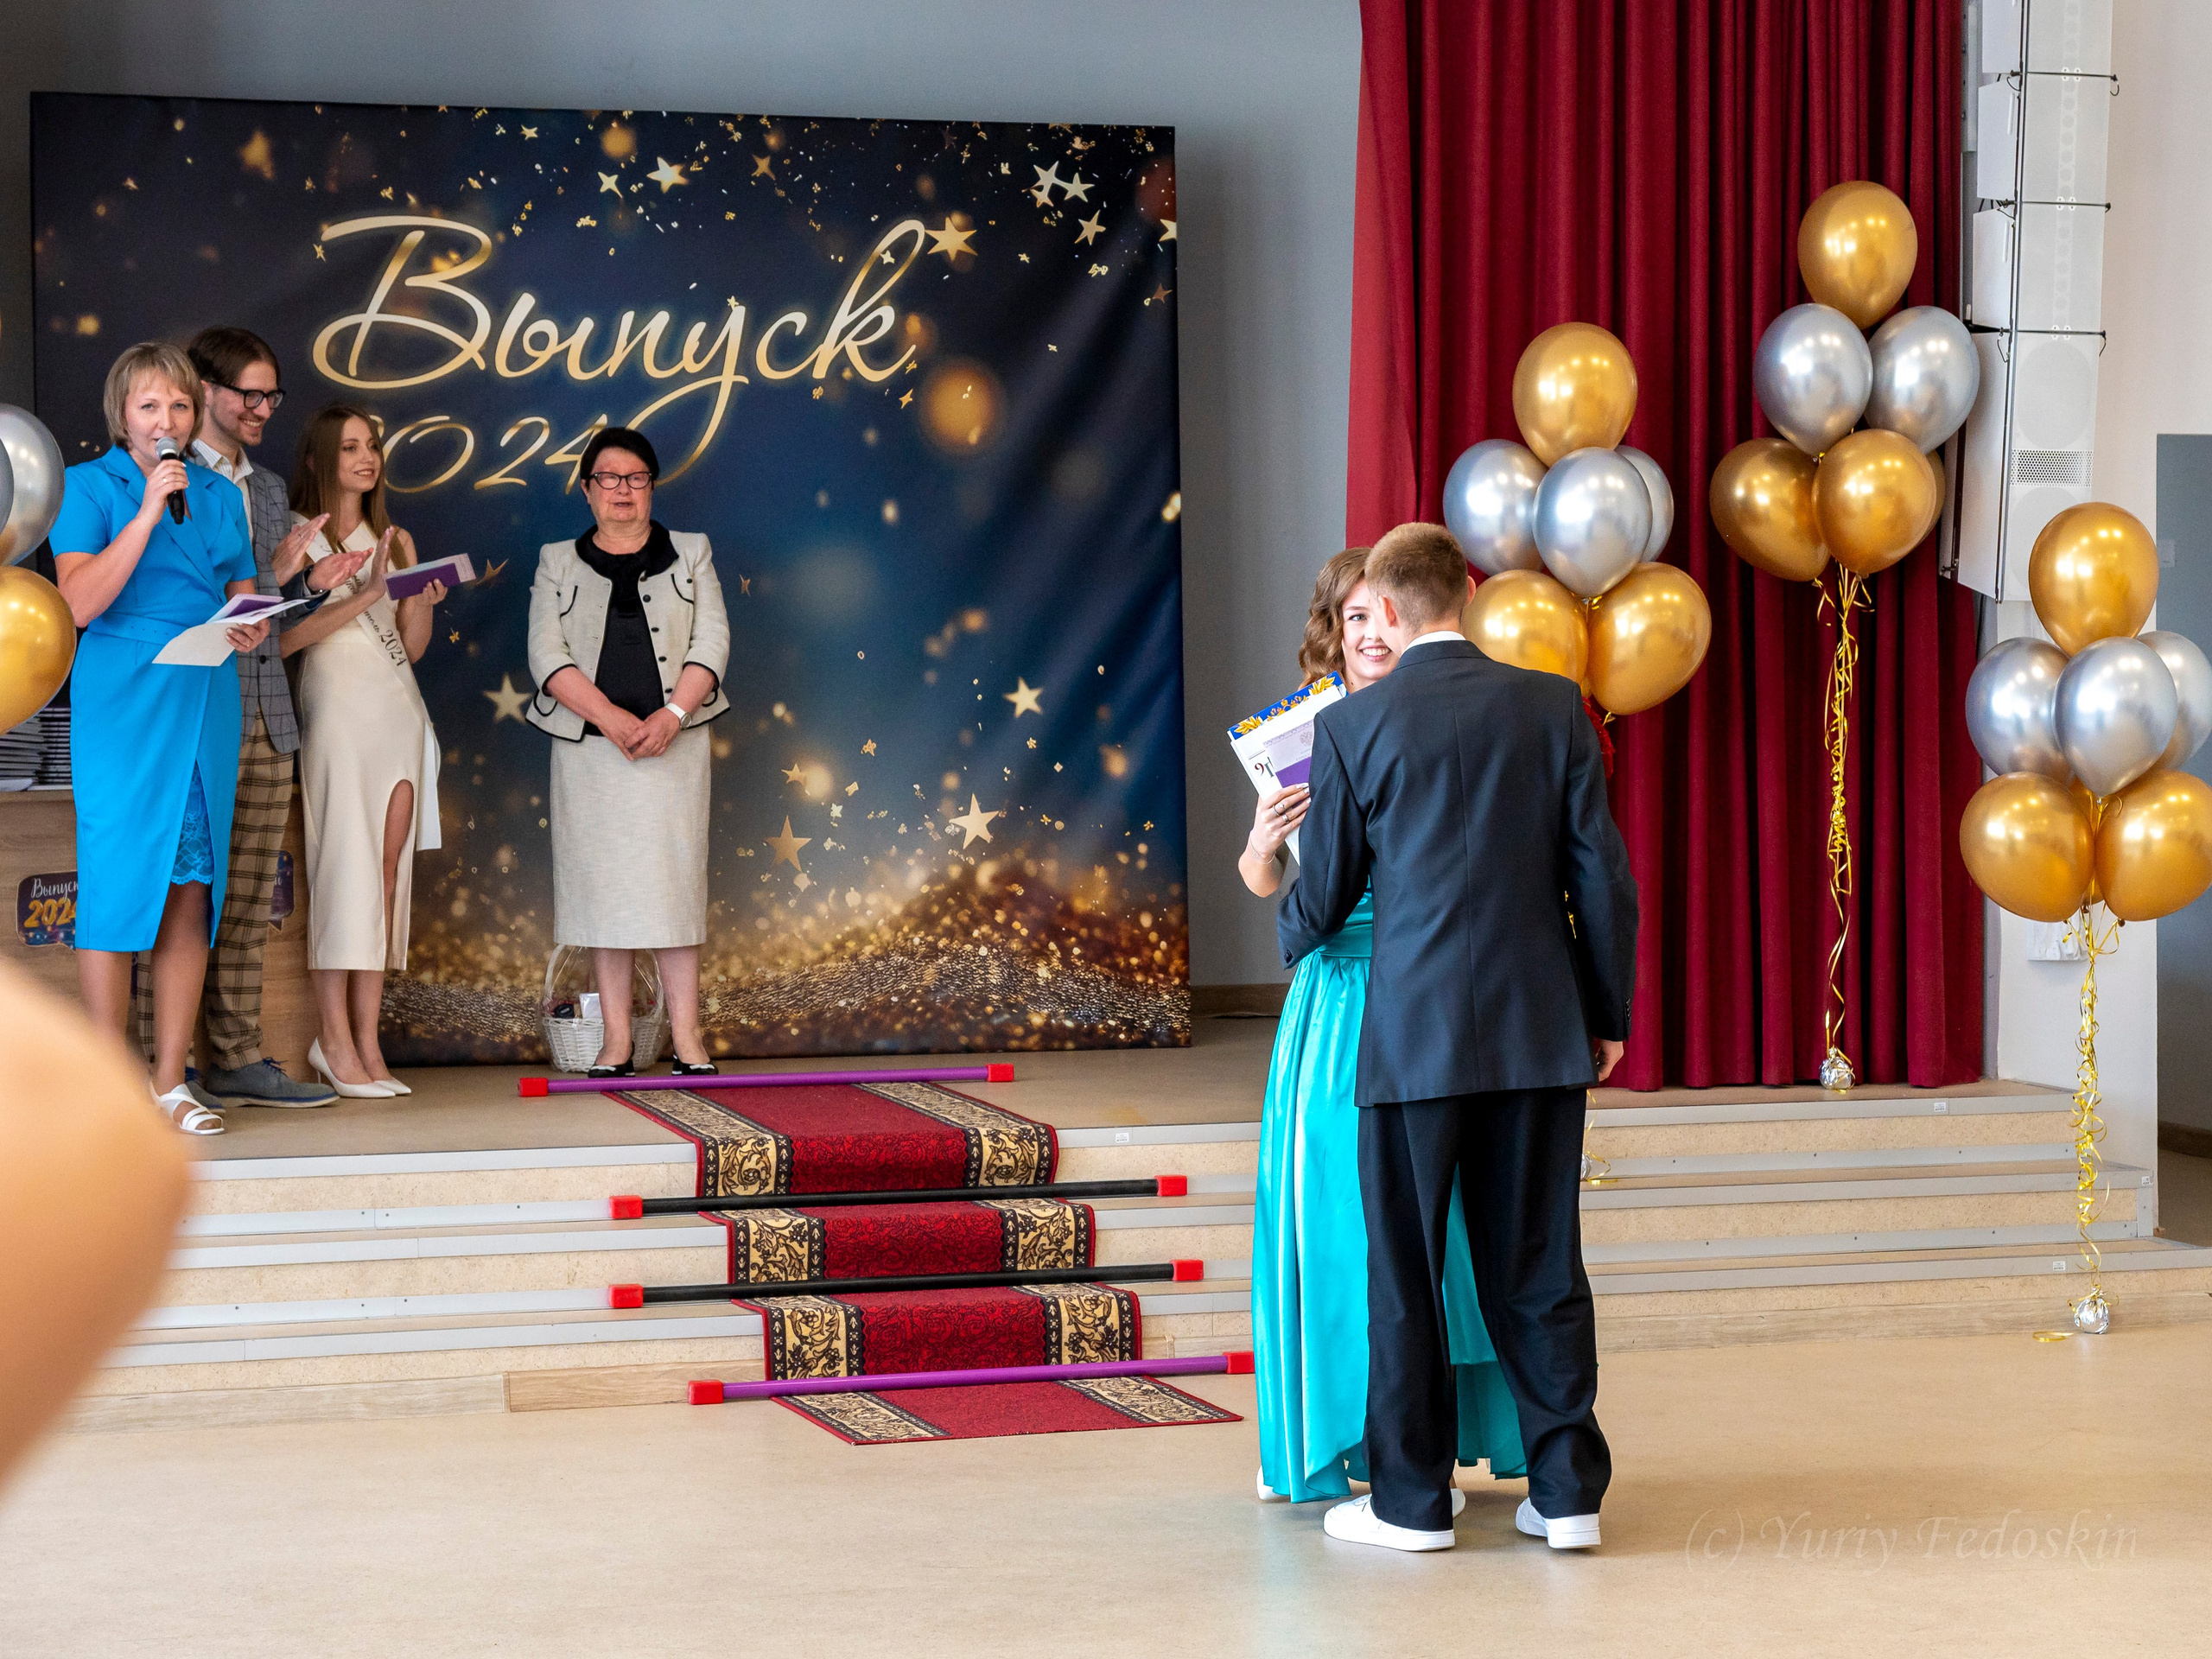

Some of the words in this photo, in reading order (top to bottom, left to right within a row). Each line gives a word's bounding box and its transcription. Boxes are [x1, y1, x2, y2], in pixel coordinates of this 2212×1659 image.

[312, 215, 925, 486] Выпуск
[368, 413, 608, 495] 024
[378, 629, 407, 667] 2024
